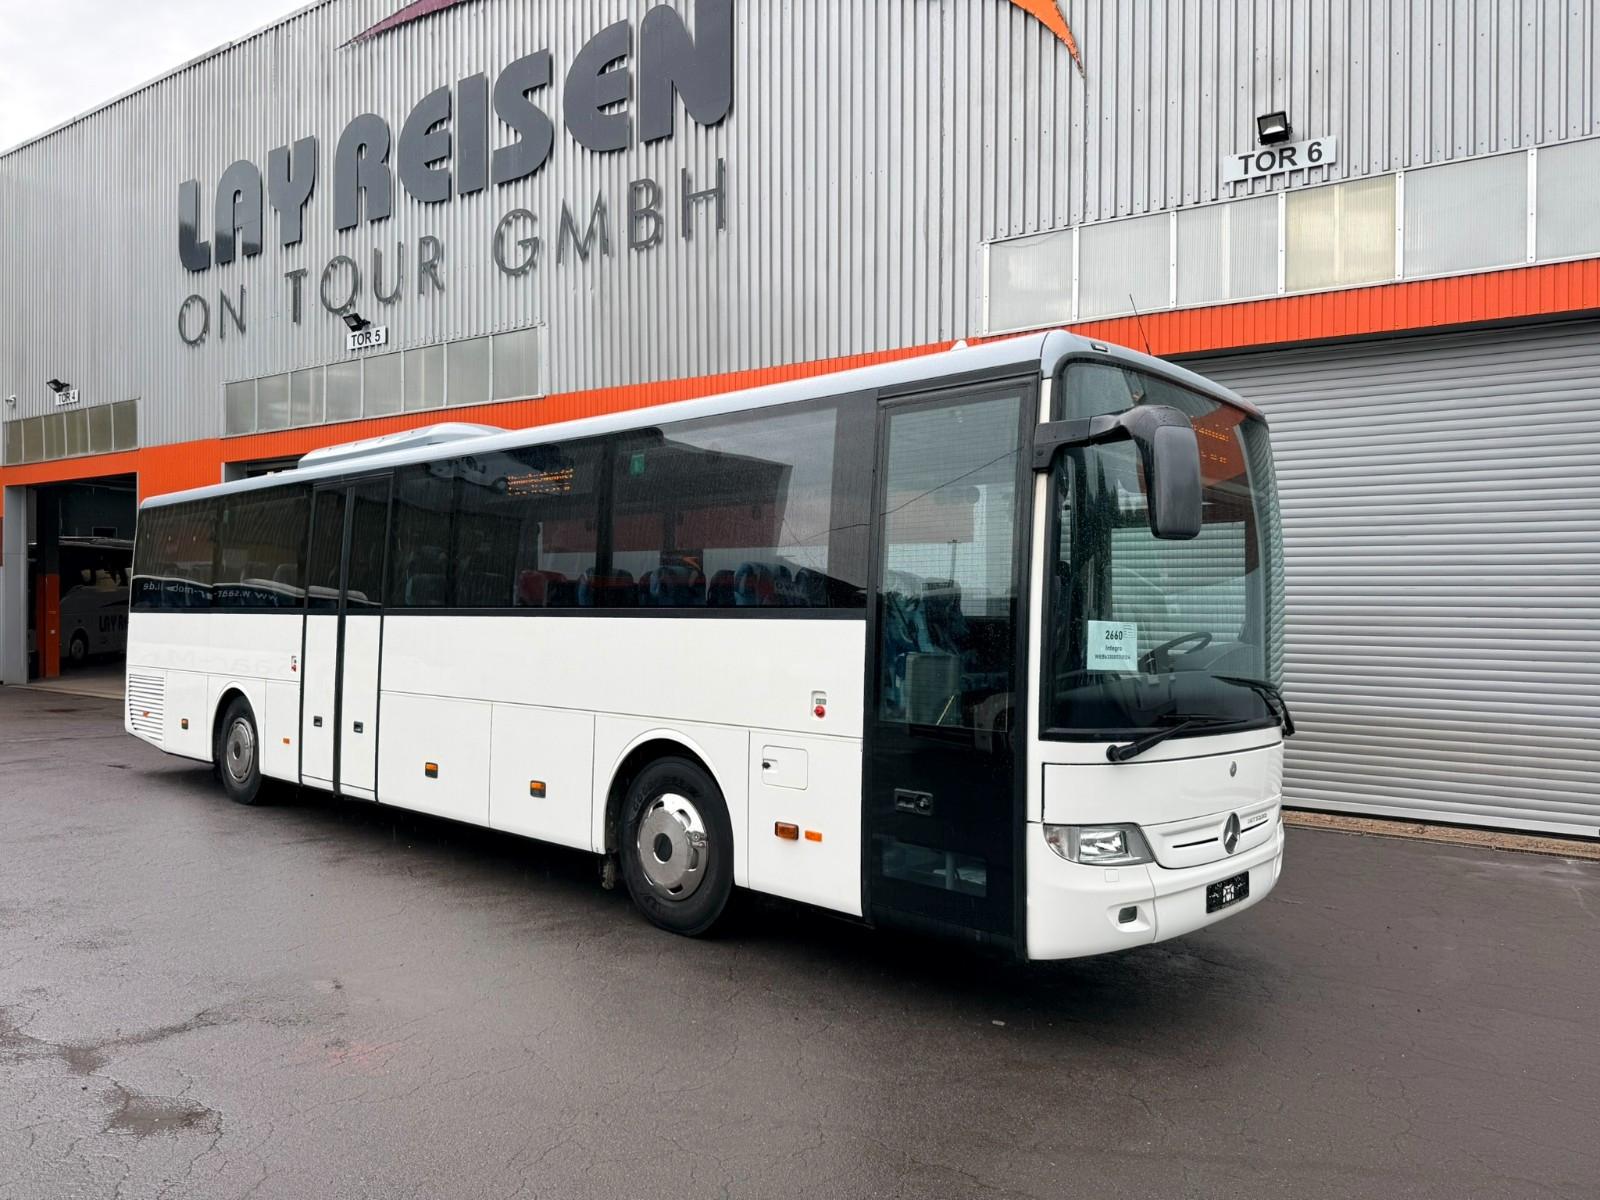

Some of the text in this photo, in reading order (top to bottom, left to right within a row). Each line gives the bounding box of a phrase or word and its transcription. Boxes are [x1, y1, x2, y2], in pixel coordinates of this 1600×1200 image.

[179, 0, 731, 271] LAY REISEN
[1238, 141, 1323, 175] TOR 6
[178, 158, 725, 345] ON TOUR GMBH
[351, 329, 381, 347] TOR 5
[58, 392, 71, 403] TOR
[1105, 630, 1123, 641] 2660
